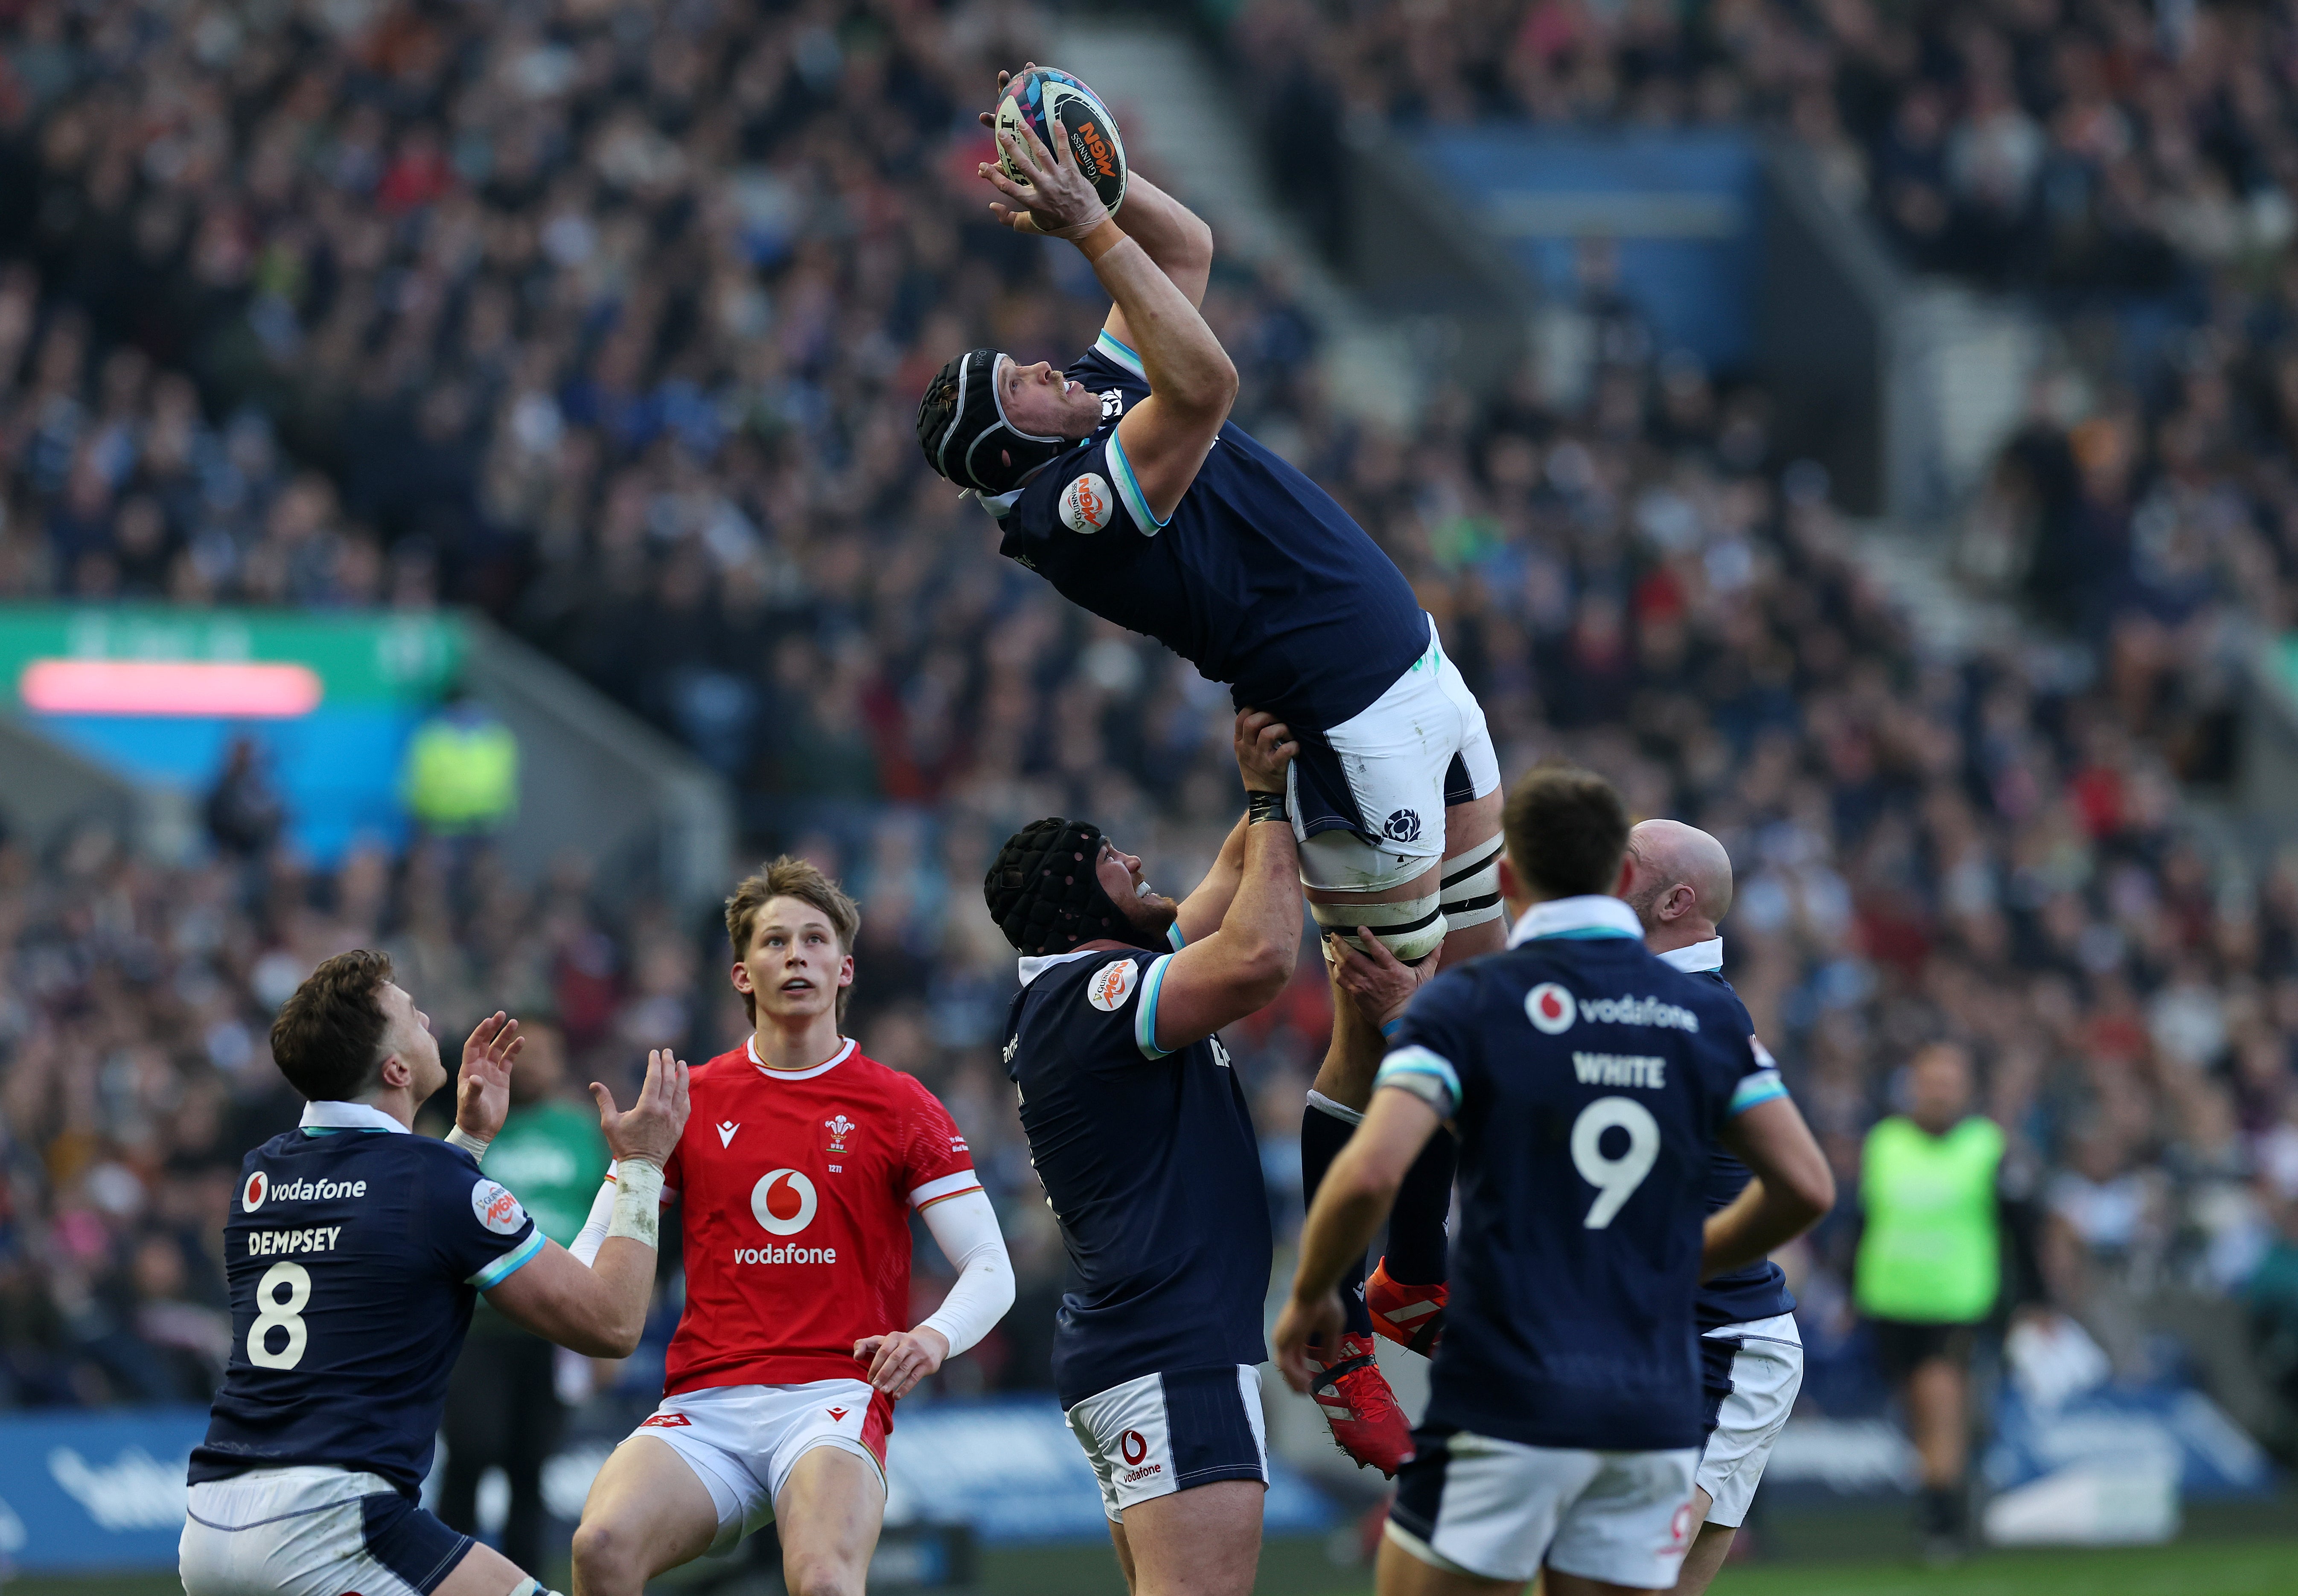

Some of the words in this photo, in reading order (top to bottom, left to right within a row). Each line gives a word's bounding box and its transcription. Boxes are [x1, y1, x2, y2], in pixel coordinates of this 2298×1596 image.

[1071, 133, 1096, 176] GUINNESS
[1071, 483, 1082, 520] GUINNESS
[1097, 963, 1120, 993] GUINNESS
[1579, 994, 1700, 1033] vodafone
[1572, 1051, 1666, 1089] WHITE
[1570, 1096, 1660, 1229] 9
[271, 1177, 367, 1201] vodafone
[248, 1226, 341, 1256] DEMPSEY
[734, 1242, 836, 1264] vodafone
[247, 1261, 312, 1370] 8
[1124, 1464, 1161, 1483] vodafone
